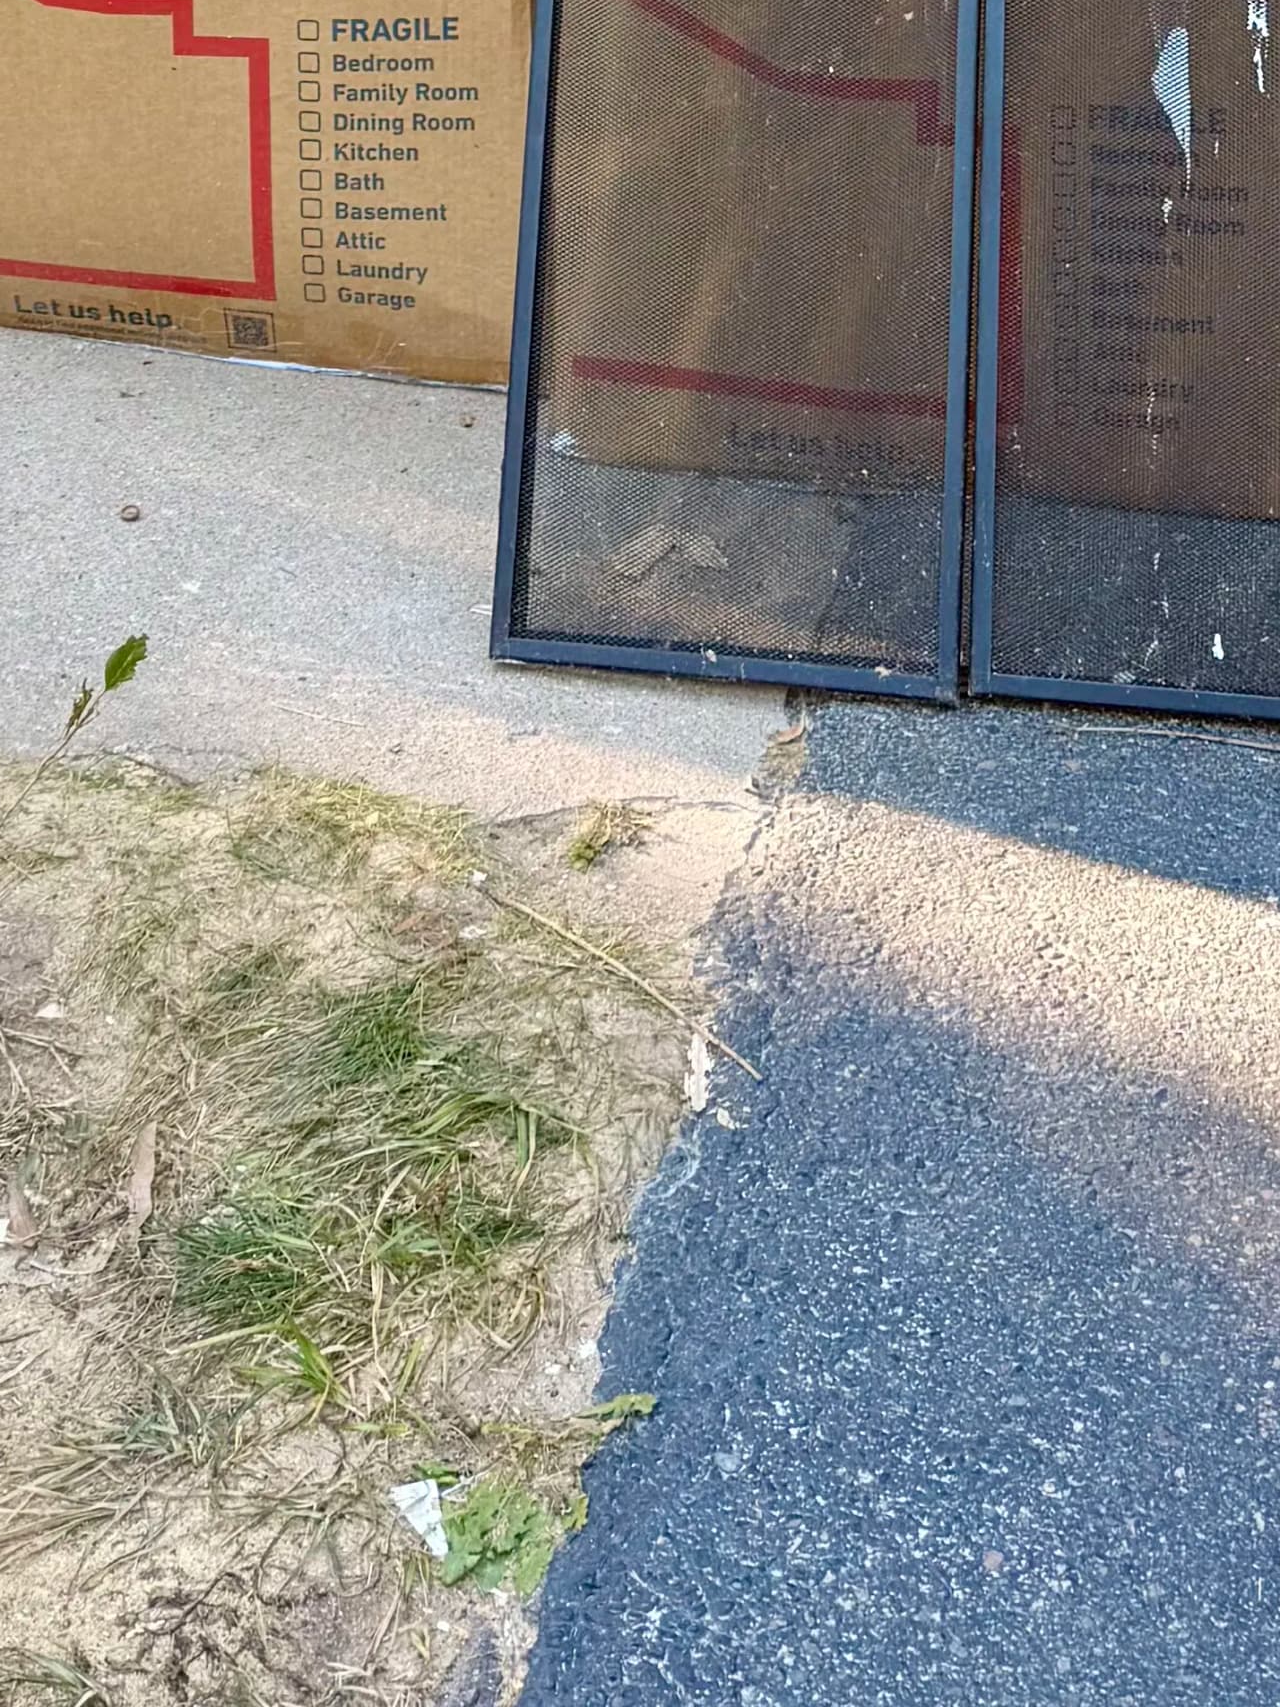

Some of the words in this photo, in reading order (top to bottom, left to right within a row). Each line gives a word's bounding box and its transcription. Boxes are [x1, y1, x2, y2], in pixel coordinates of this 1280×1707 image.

[331, 17, 460, 43] FRAGILE
[333, 54, 435, 73] Bedroom
[333, 83, 409, 106] Family
[415, 83, 480, 102] Room
[333, 113, 405, 135] Dining
[412, 112, 476, 132] Room
[333, 142, 420, 162] Kitchen
[334, 172, 386, 191] Bath
[334, 201, 448, 222] Basement
[335, 231, 387, 251] Attic
[336, 259, 429, 285] Laundry
[337, 286, 417, 311] Garage
[14, 294, 61, 317] Let
[70, 302, 101, 321] us
[109, 304, 183, 329] help.
